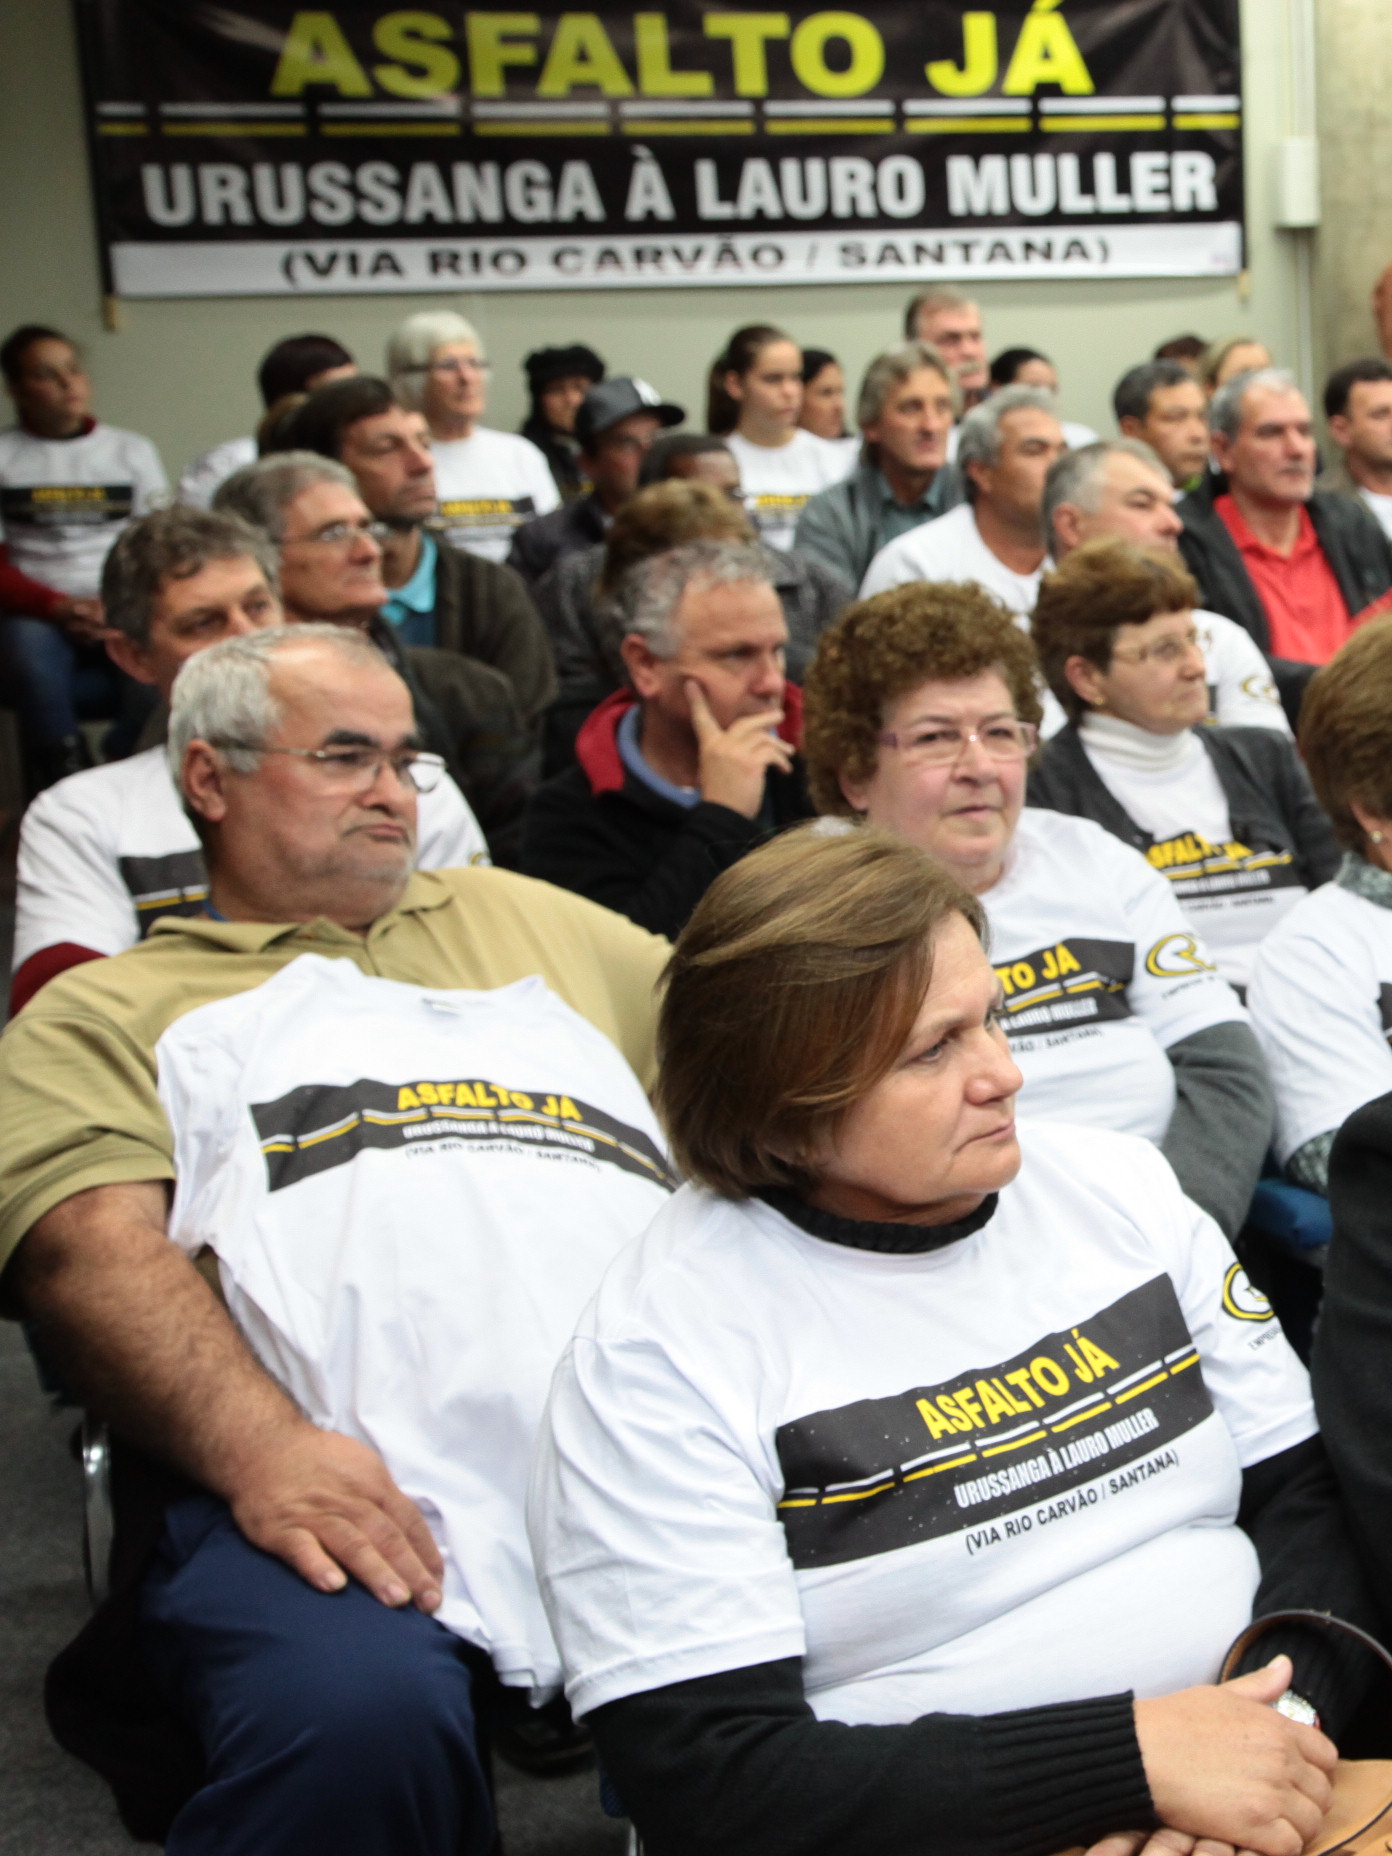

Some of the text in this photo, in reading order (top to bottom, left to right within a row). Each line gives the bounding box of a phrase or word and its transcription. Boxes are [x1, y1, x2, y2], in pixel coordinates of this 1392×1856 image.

[270, 0, 1096, 98] ASFALTO JÁ
[141, 144, 1218, 226] URUSSANGA À LAURO MULLER
[281, 248, 404, 287] (VIA
[428, 248, 526, 277] RIO
[549, 234, 784, 276] CARVÃO
[840, 237, 1111, 269] SANTANA)
[397, 1081, 535, 1112] ASFALTO
[916, 1328, 1120, 1440] ASFALTO JÁ
[953, 1407, 1161, 1508] URUSSANGA À LAURO MULLER
[964, 1524, 1003, 1556] (VIA
[1004, 1514, 1034, 1539] RIO
[1036, 1487, 1099, 1526] CARVÃO
[1108, 1449, 1180, 1495] SANTANA)
